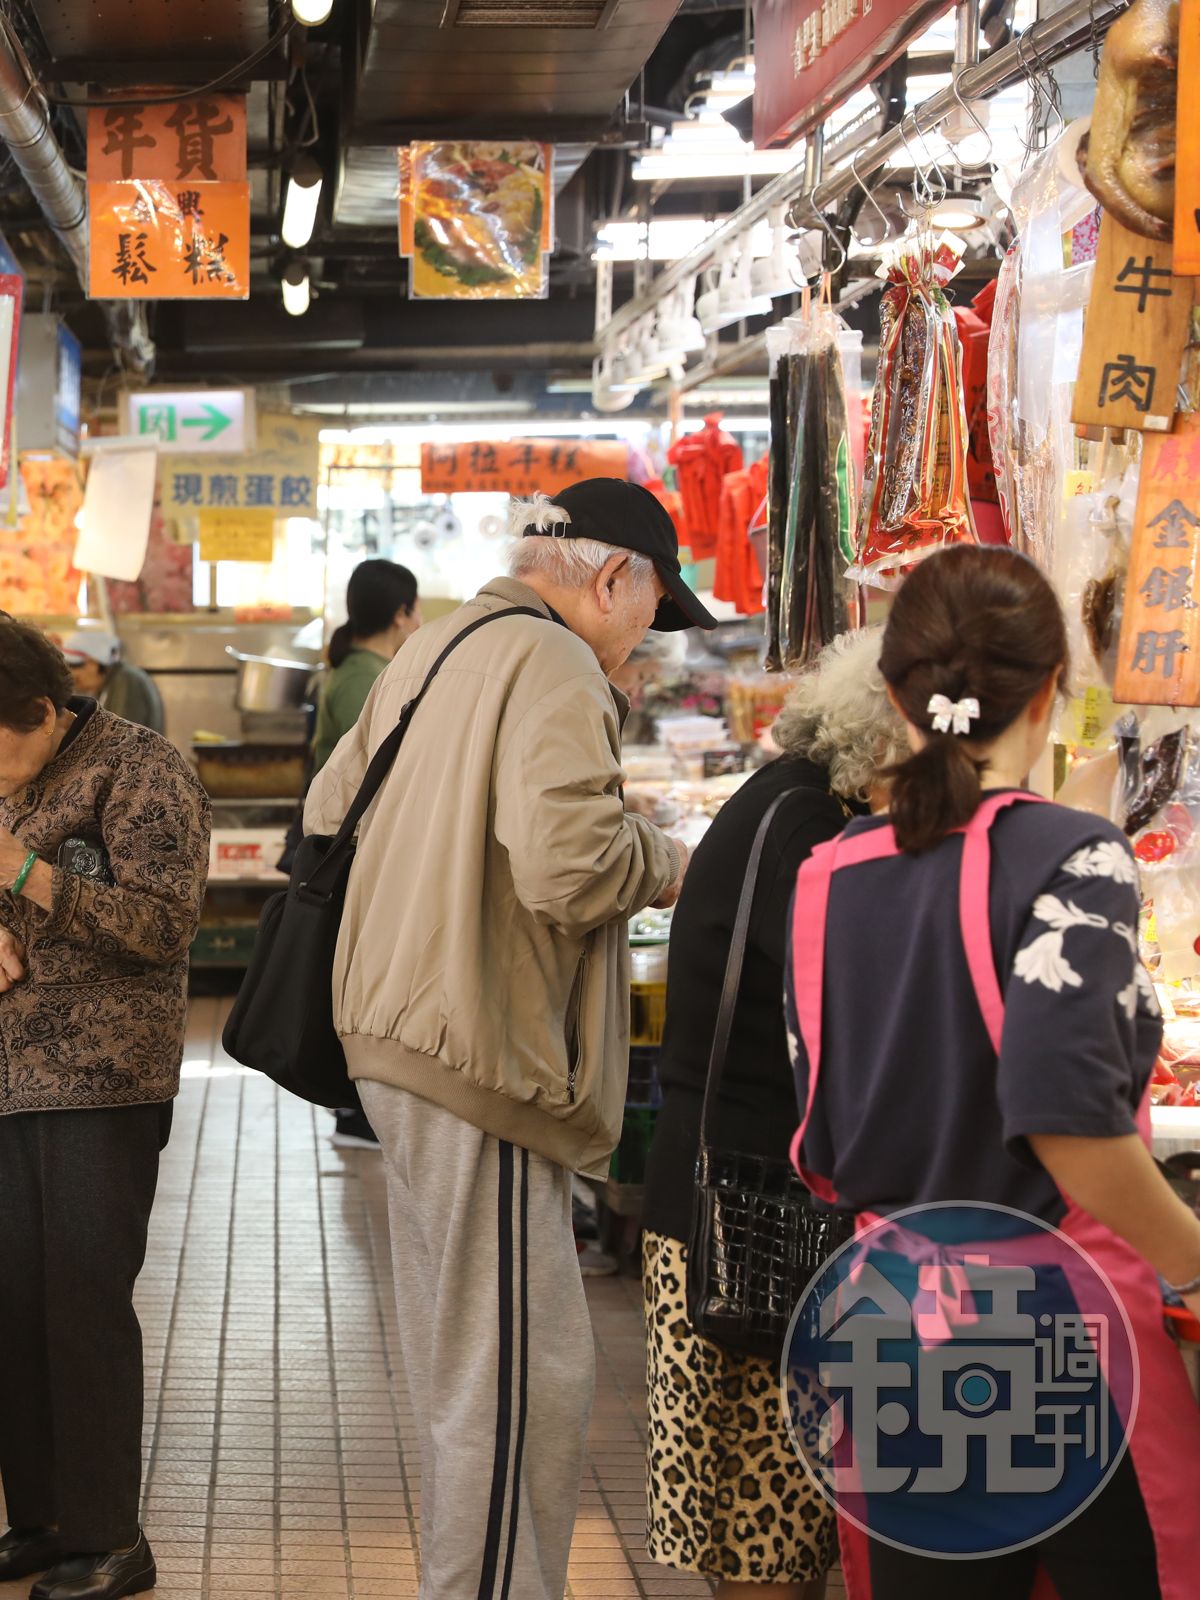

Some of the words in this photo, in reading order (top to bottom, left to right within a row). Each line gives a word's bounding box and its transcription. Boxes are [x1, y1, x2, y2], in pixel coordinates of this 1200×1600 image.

[102, 102, 232, 180] 年貨
[1098, 255, 1173, 412] 牛肉
[172, 473, 312, 507] 現煎蛋餃
[1128, 498, 1200, 679] 金銀肝
